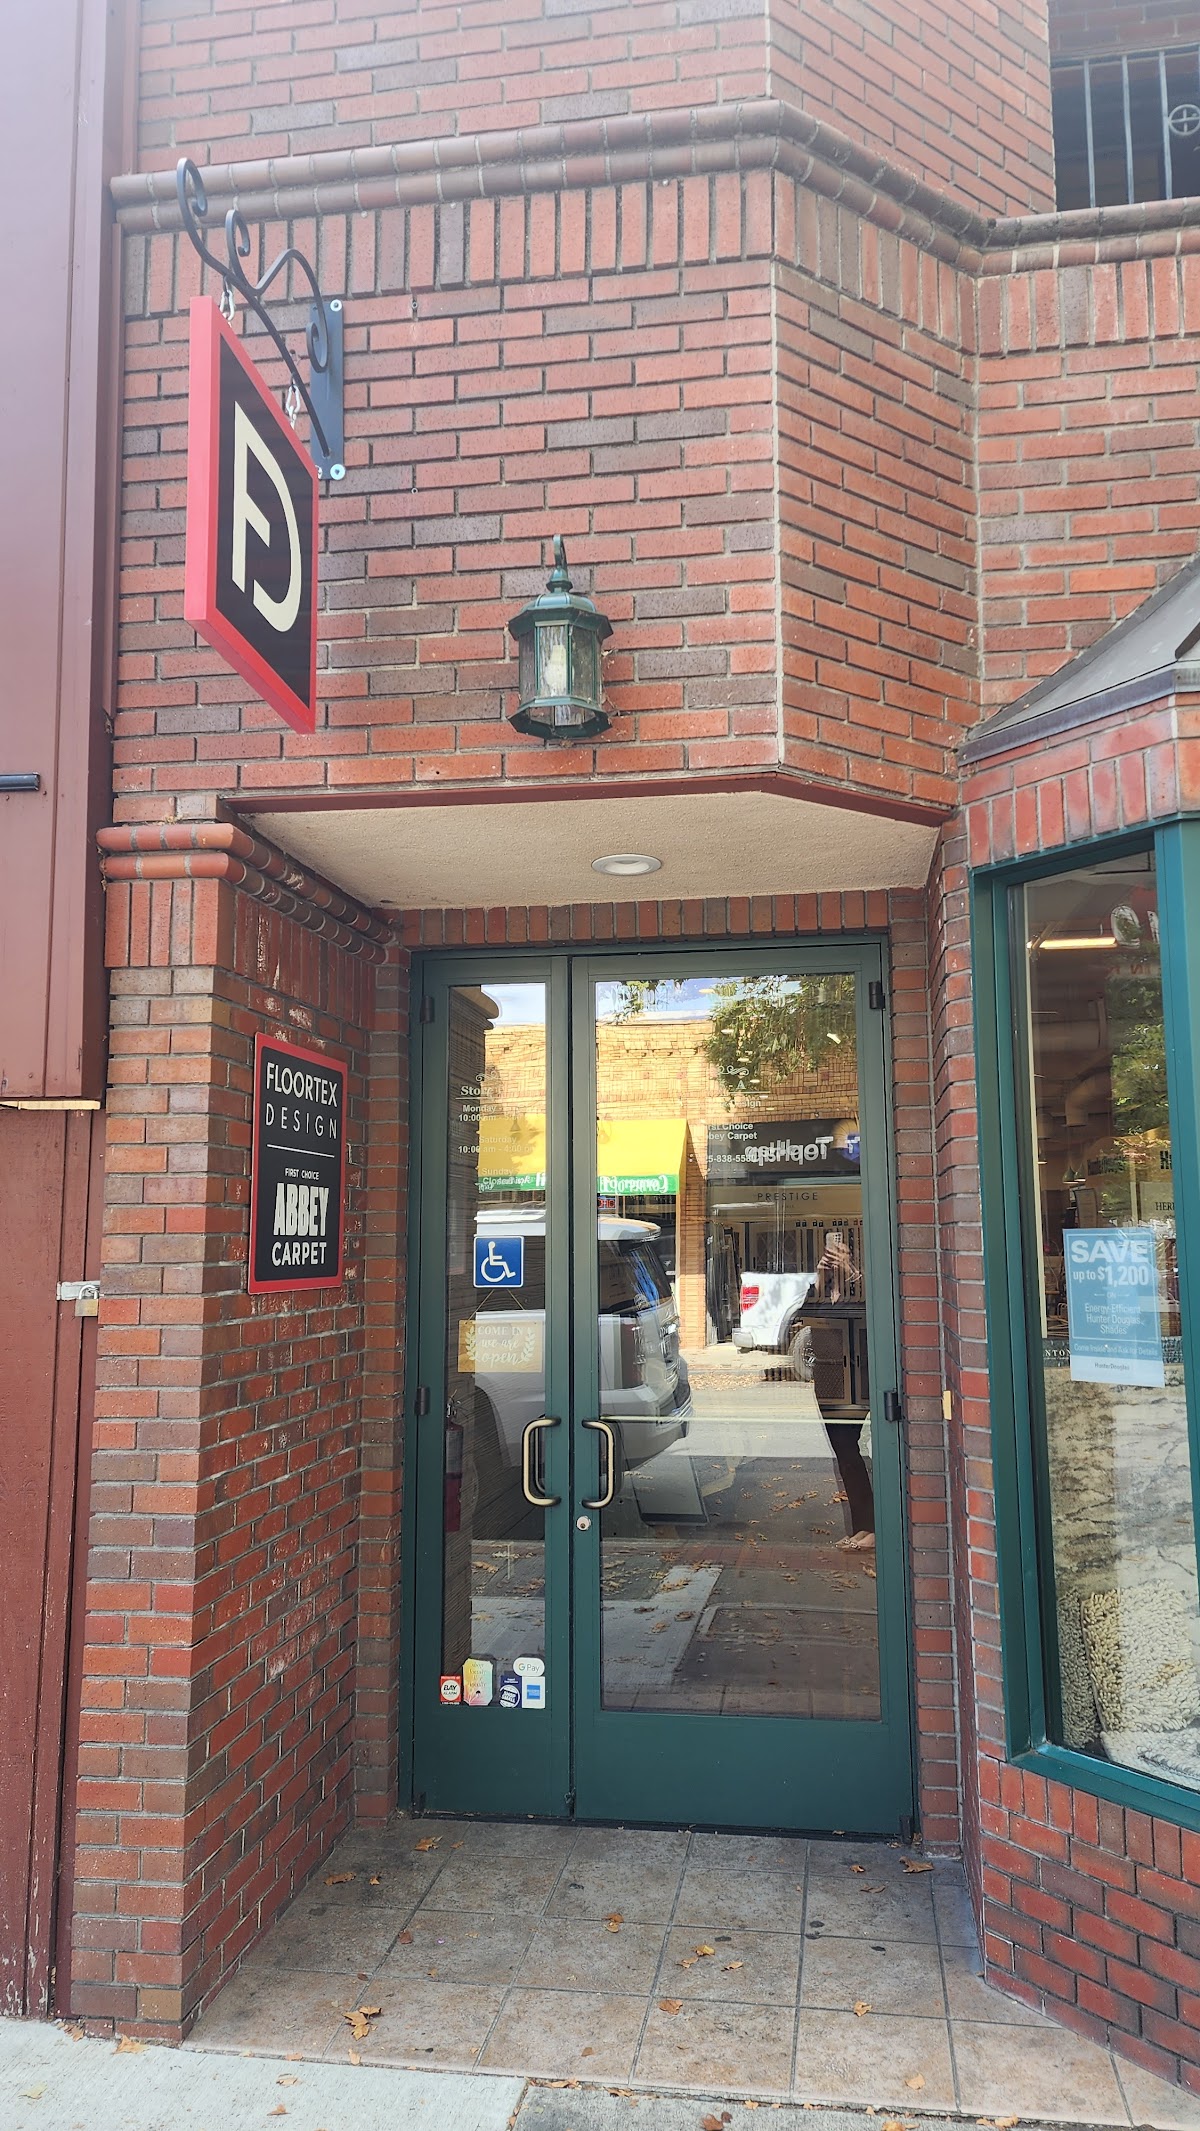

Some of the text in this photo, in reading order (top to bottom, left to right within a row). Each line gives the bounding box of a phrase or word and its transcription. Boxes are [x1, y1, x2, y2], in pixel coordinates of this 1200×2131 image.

[266, 1061, 338, 1108] FLOORTEX
[462, 1104, 496, 1113] Monday
[266, 1102, 337, 1140] DESIGN
[723, 1122, 754, 1130] Choice
[727, 1132, 758, 1141] Carpet
[458, 1145, 480, 1153] 10:00
[285, 1167, 320, 1181] FIRST CHOICE
[757, 1191, 819, 1201] PRESTIGE
[273, 1182, 330, 1237] ABBEY
[271, 1241, 327, 1267] CARPET
[1071, 1239, 1149, 1263] SAVE
[1072, 1265, 1149, 1287] up to $1,200
[1086, 1314, 1140, 1326] Hunter Douglas
[477, 1325, 523, 1336] COME IN
[1100, 1324, 1127, 1335] Shades
[480, 1352, 521, 1368] open
[526, 1663, 540, 1672] Pay
